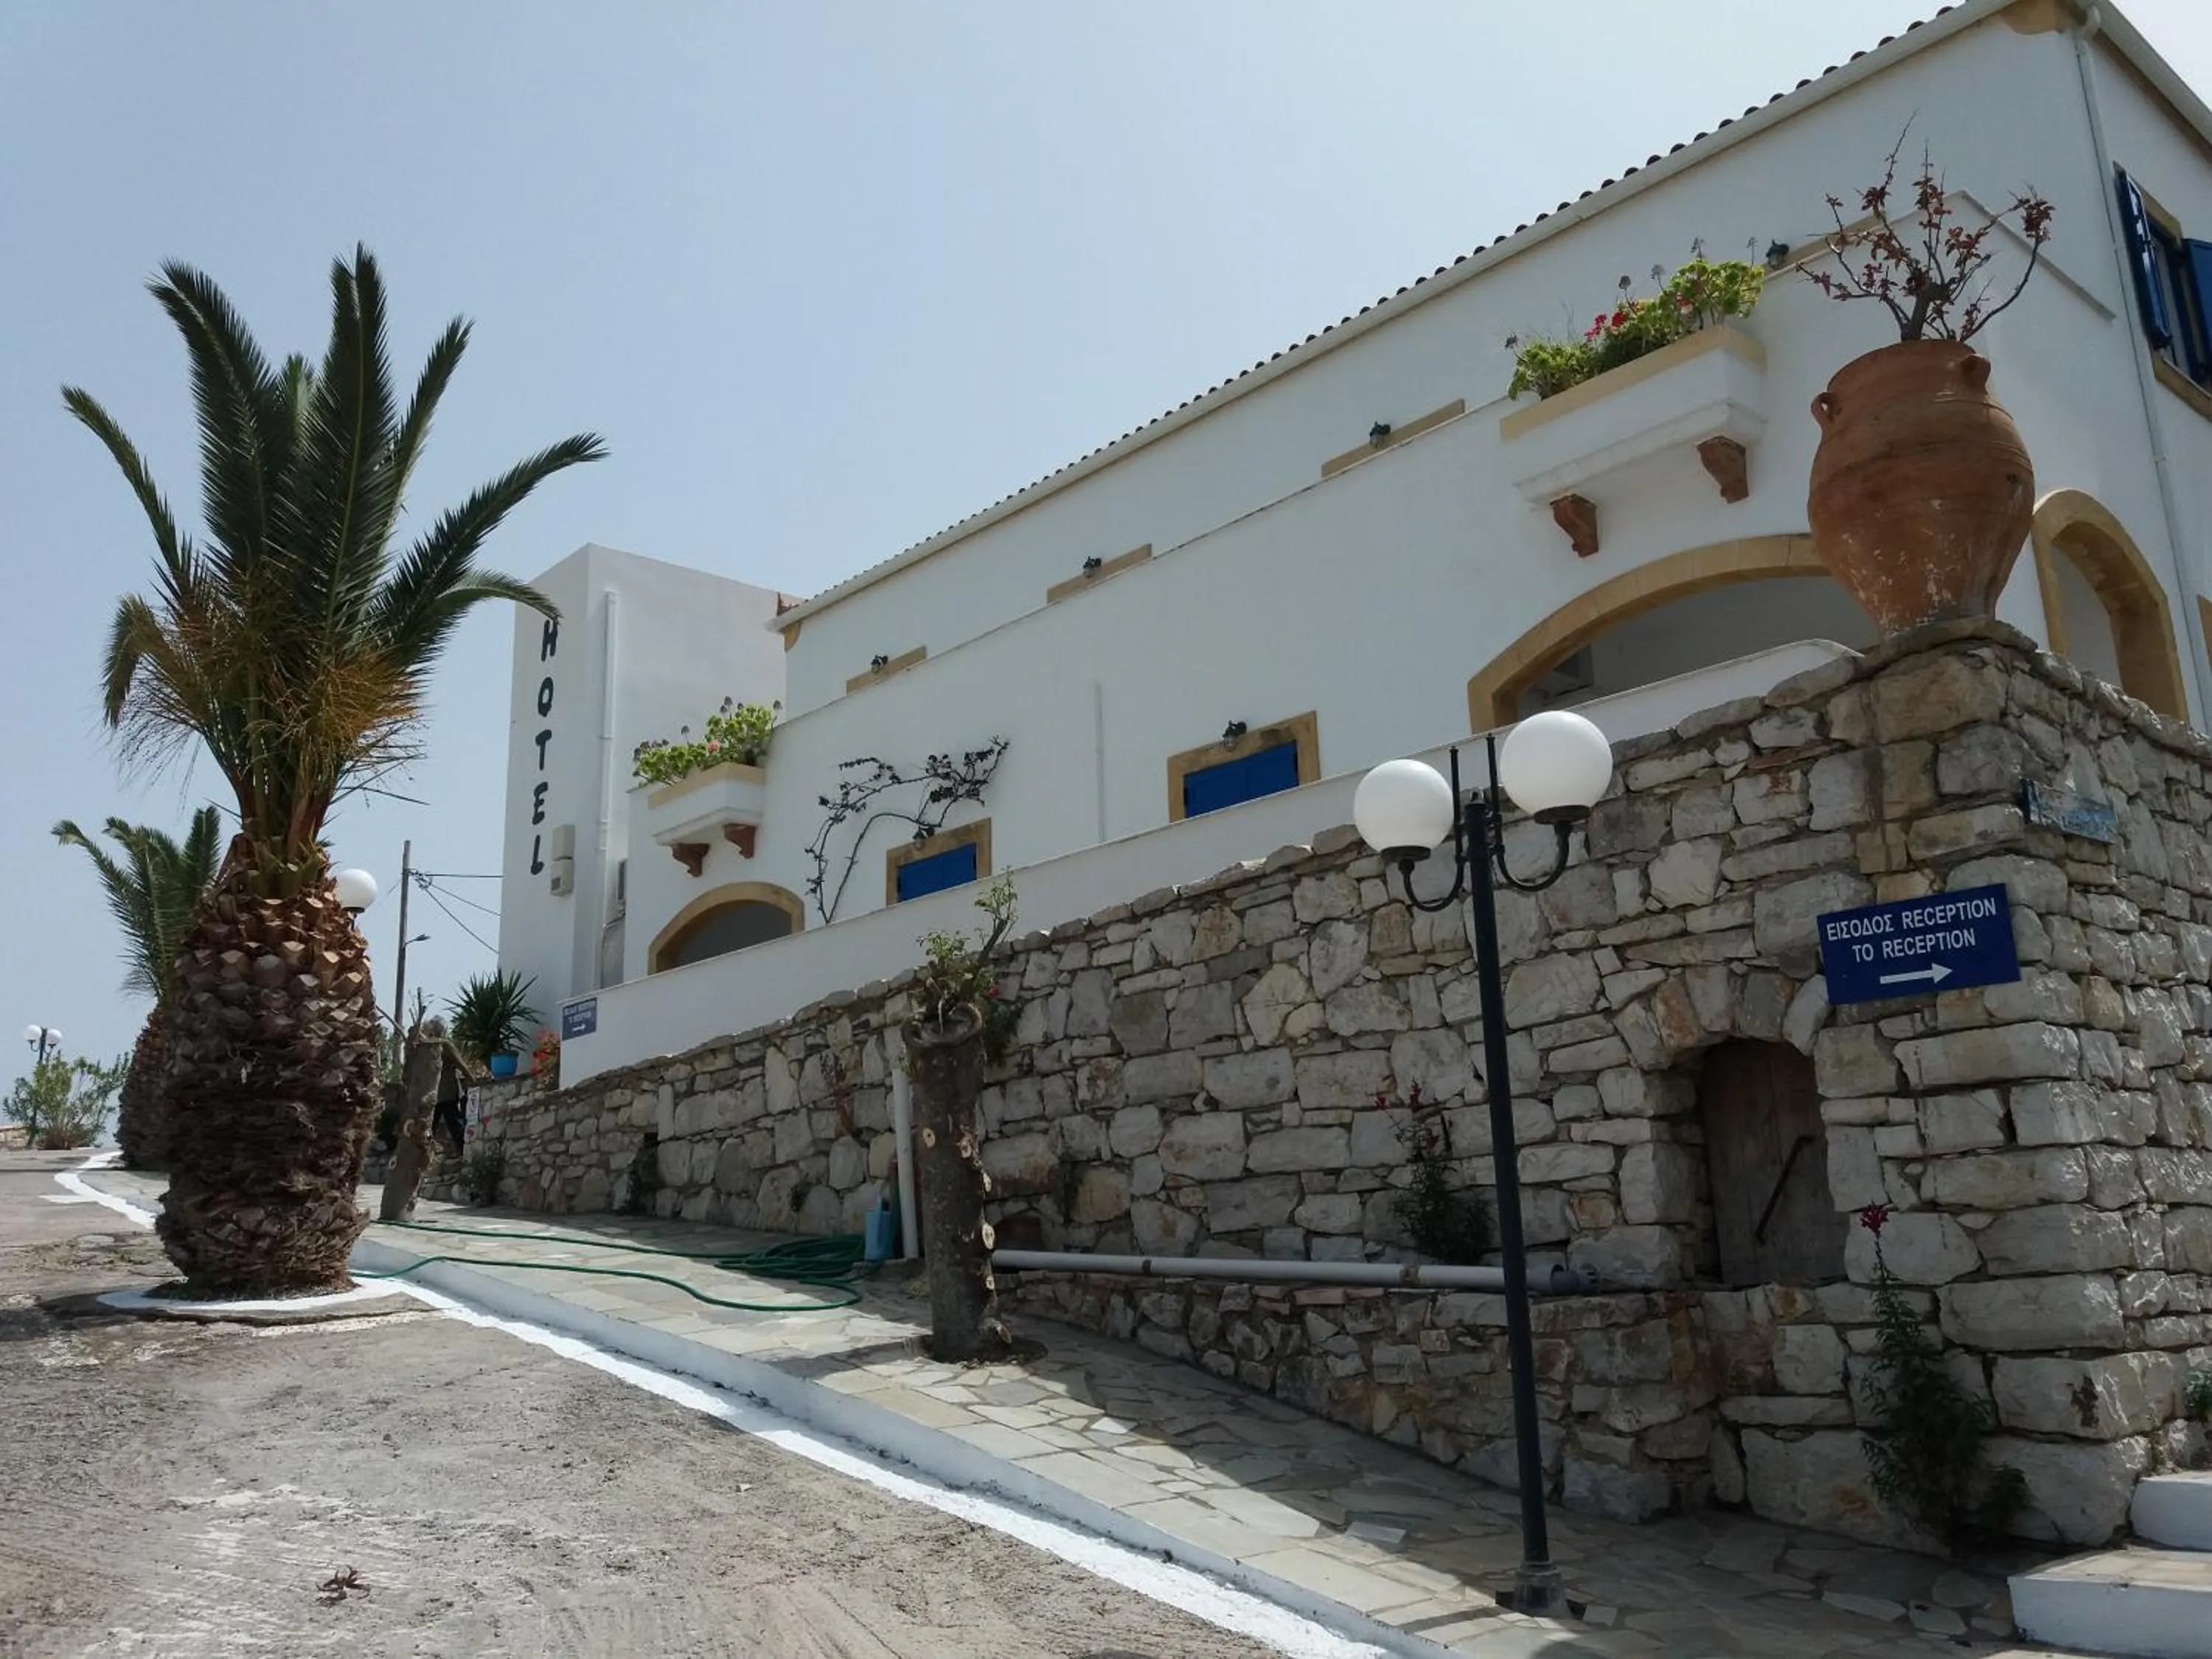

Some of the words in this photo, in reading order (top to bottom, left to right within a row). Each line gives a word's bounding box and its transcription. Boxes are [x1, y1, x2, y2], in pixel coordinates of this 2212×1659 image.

[531, 619, 558, 875] HOTEL
[1826, 914, 1894, 941] ΕΙΣΟΔΟΣ
[1902, 897, 1997, 930] RECEPTION
[1852, 943, 1874, 962] TO
[1882, 928, 1976, 959] RECEPTION
